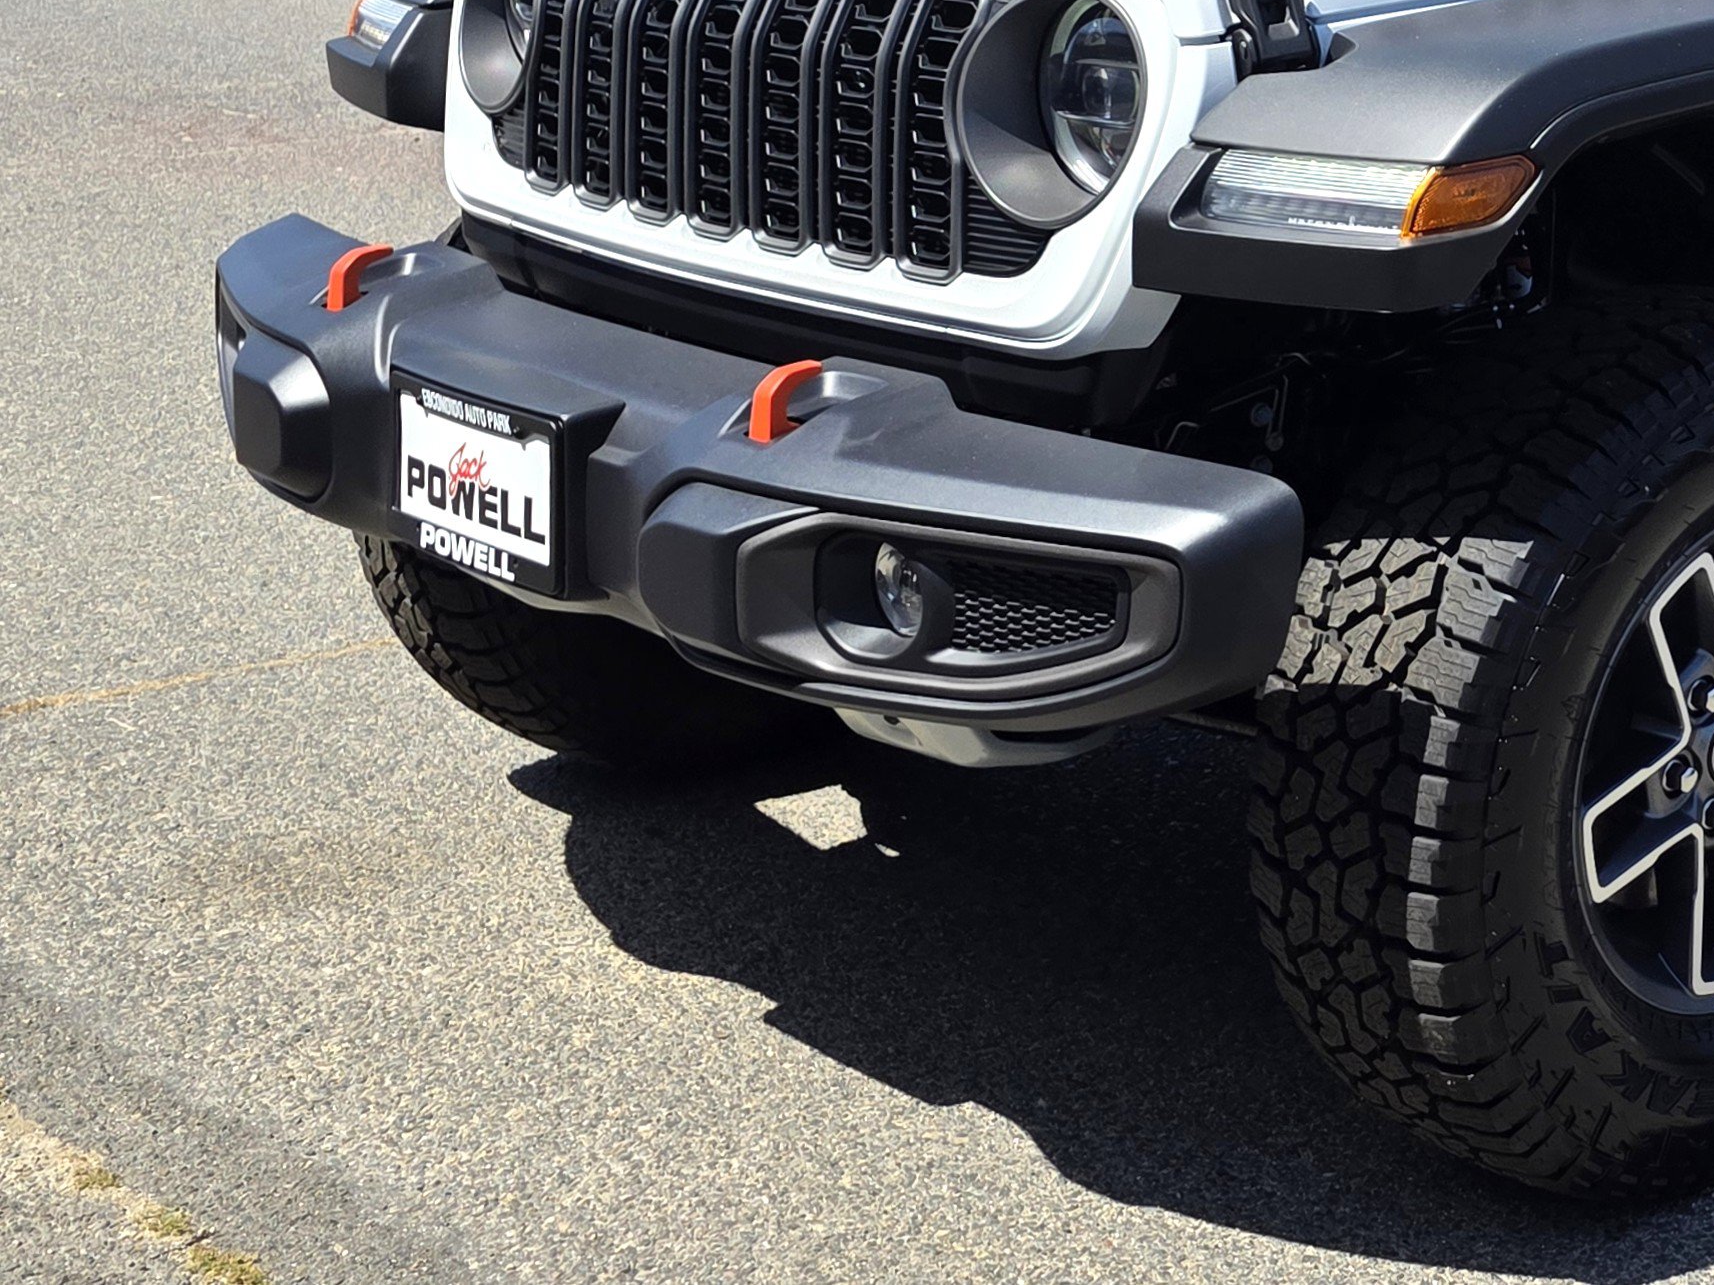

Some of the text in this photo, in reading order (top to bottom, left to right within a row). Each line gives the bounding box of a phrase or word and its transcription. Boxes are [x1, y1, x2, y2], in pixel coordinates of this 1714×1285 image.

[464, 404, 488, 429] AUTO
[487, 410, 512, 435] PARK
[448, 442, 490, 496] Jack
[407, 455, 546, 545] POWELL
[420, 521, 515, 582] POWELL
